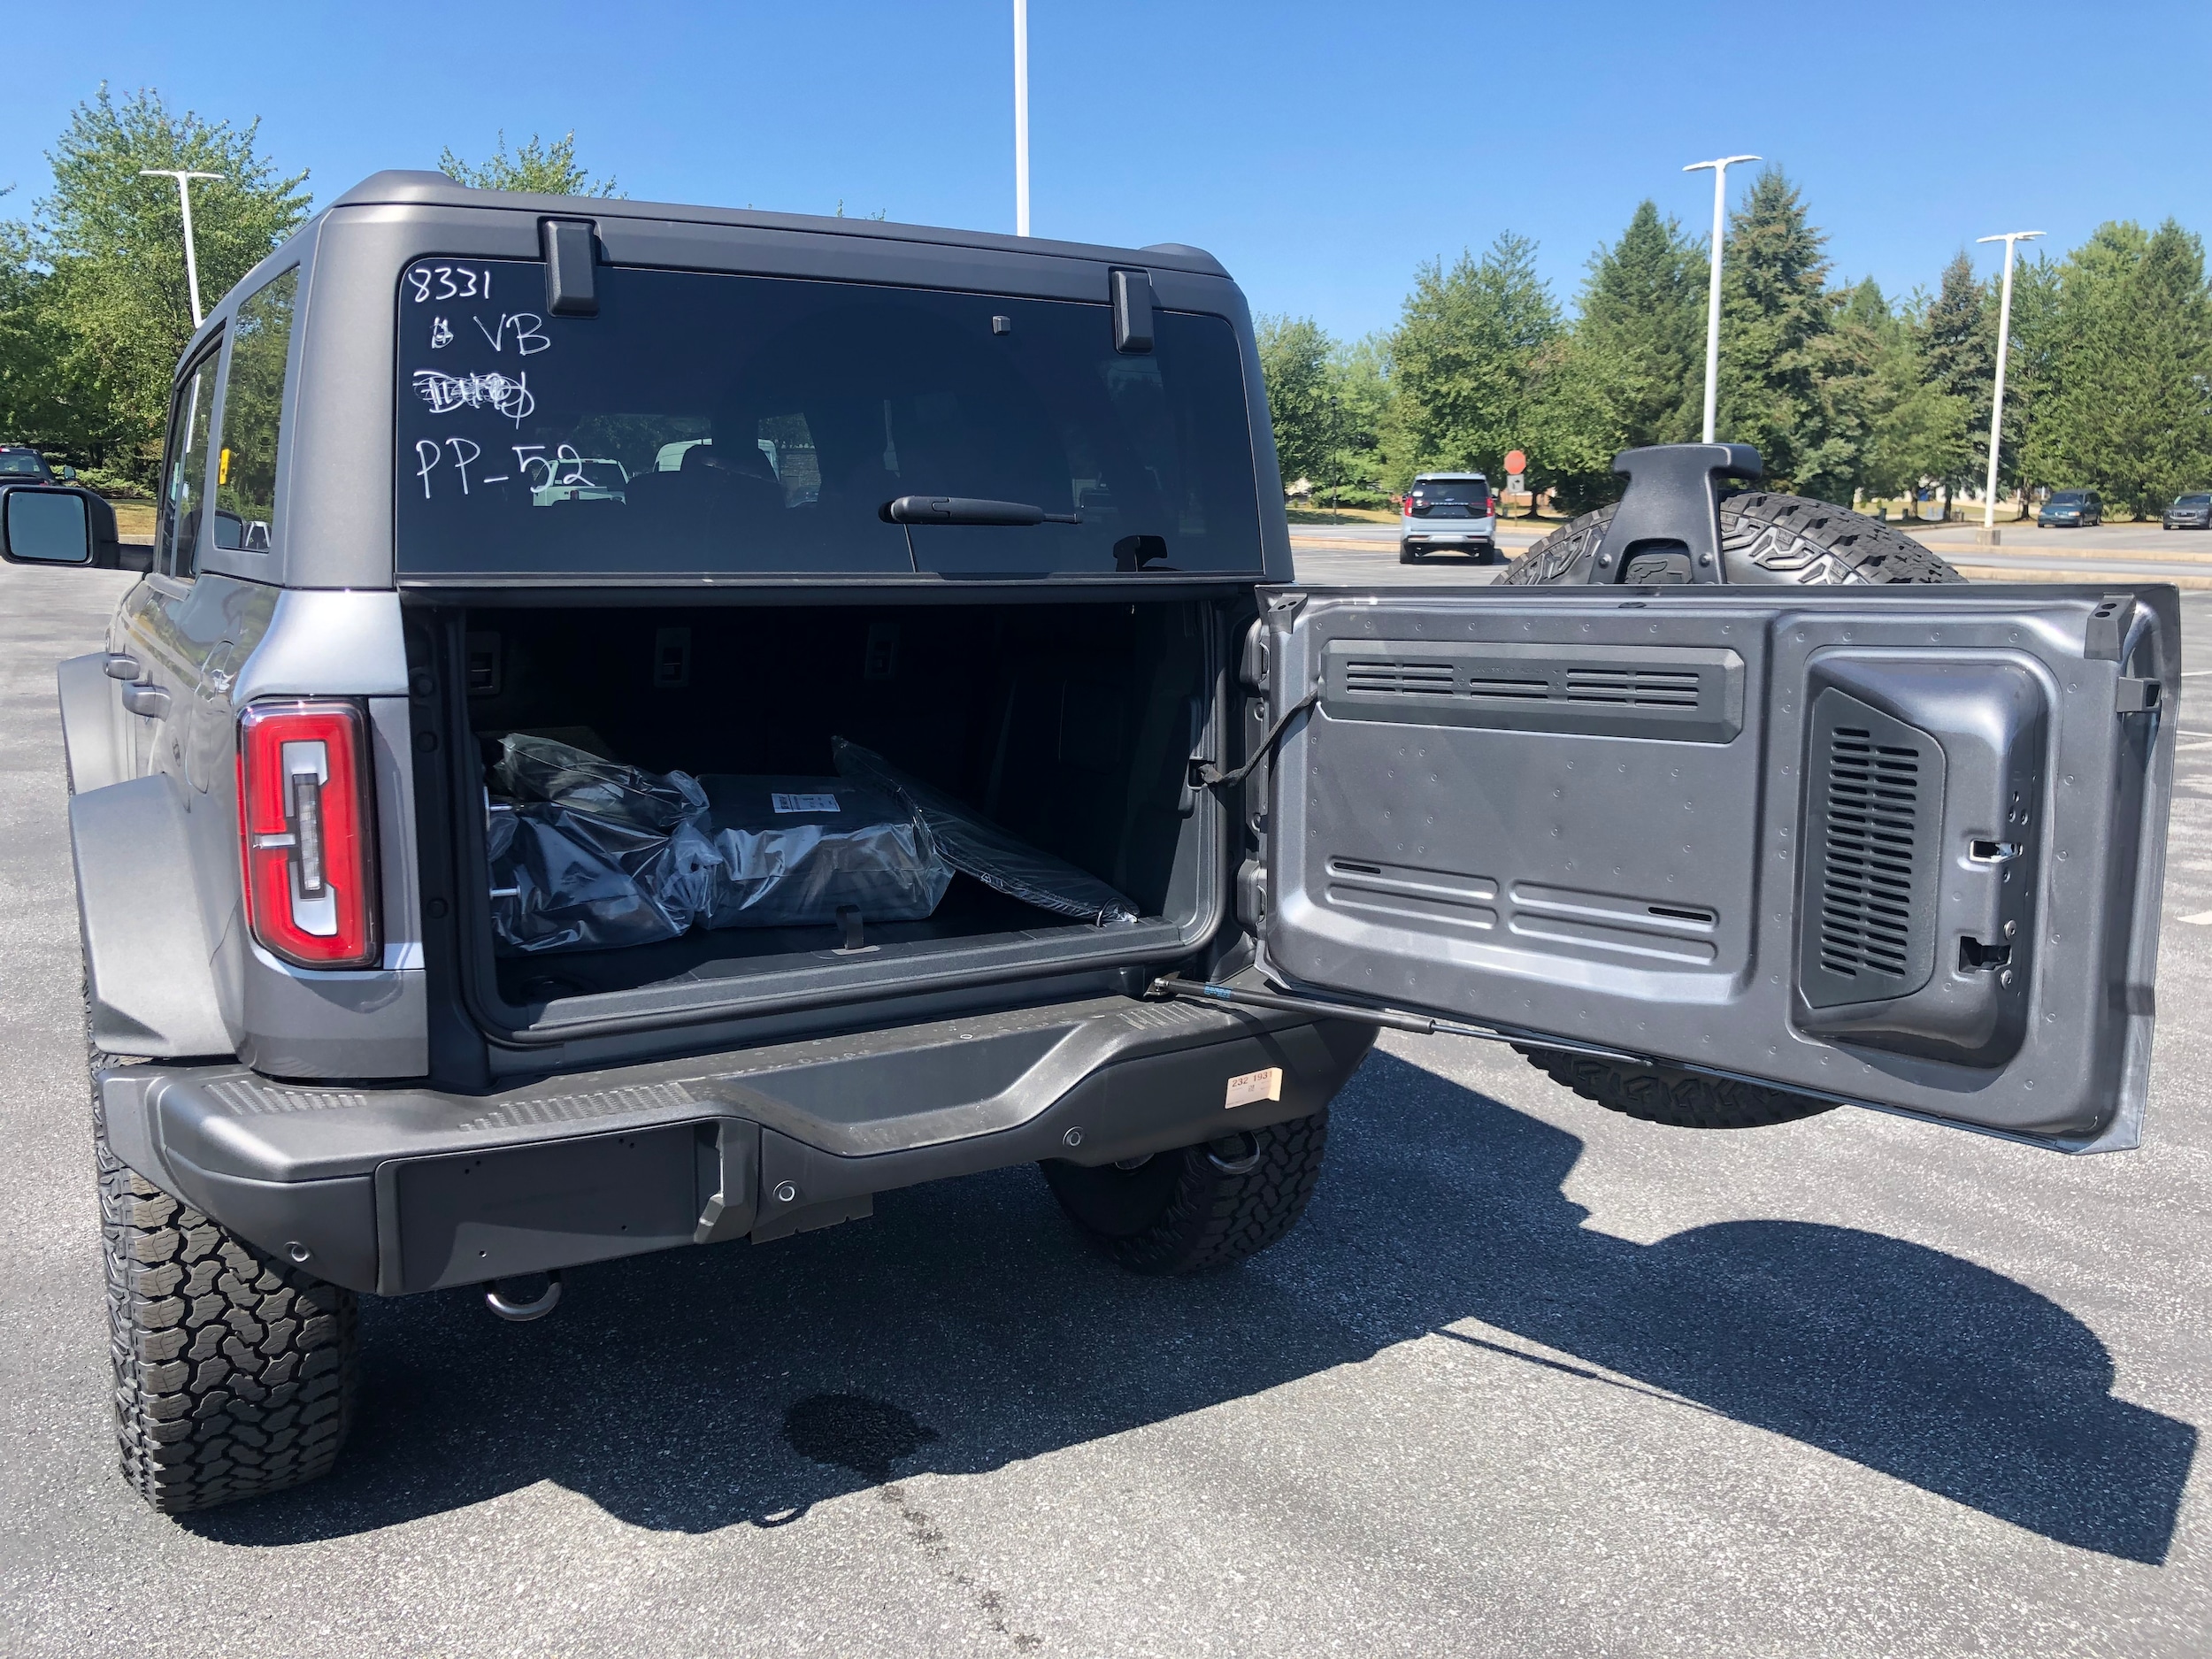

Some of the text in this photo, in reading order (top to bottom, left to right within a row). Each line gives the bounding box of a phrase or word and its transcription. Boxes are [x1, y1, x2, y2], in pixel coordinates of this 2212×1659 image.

[408, 267, 490, 303] 8331
[1232, 1071, 1272, 1087] 232 1931
